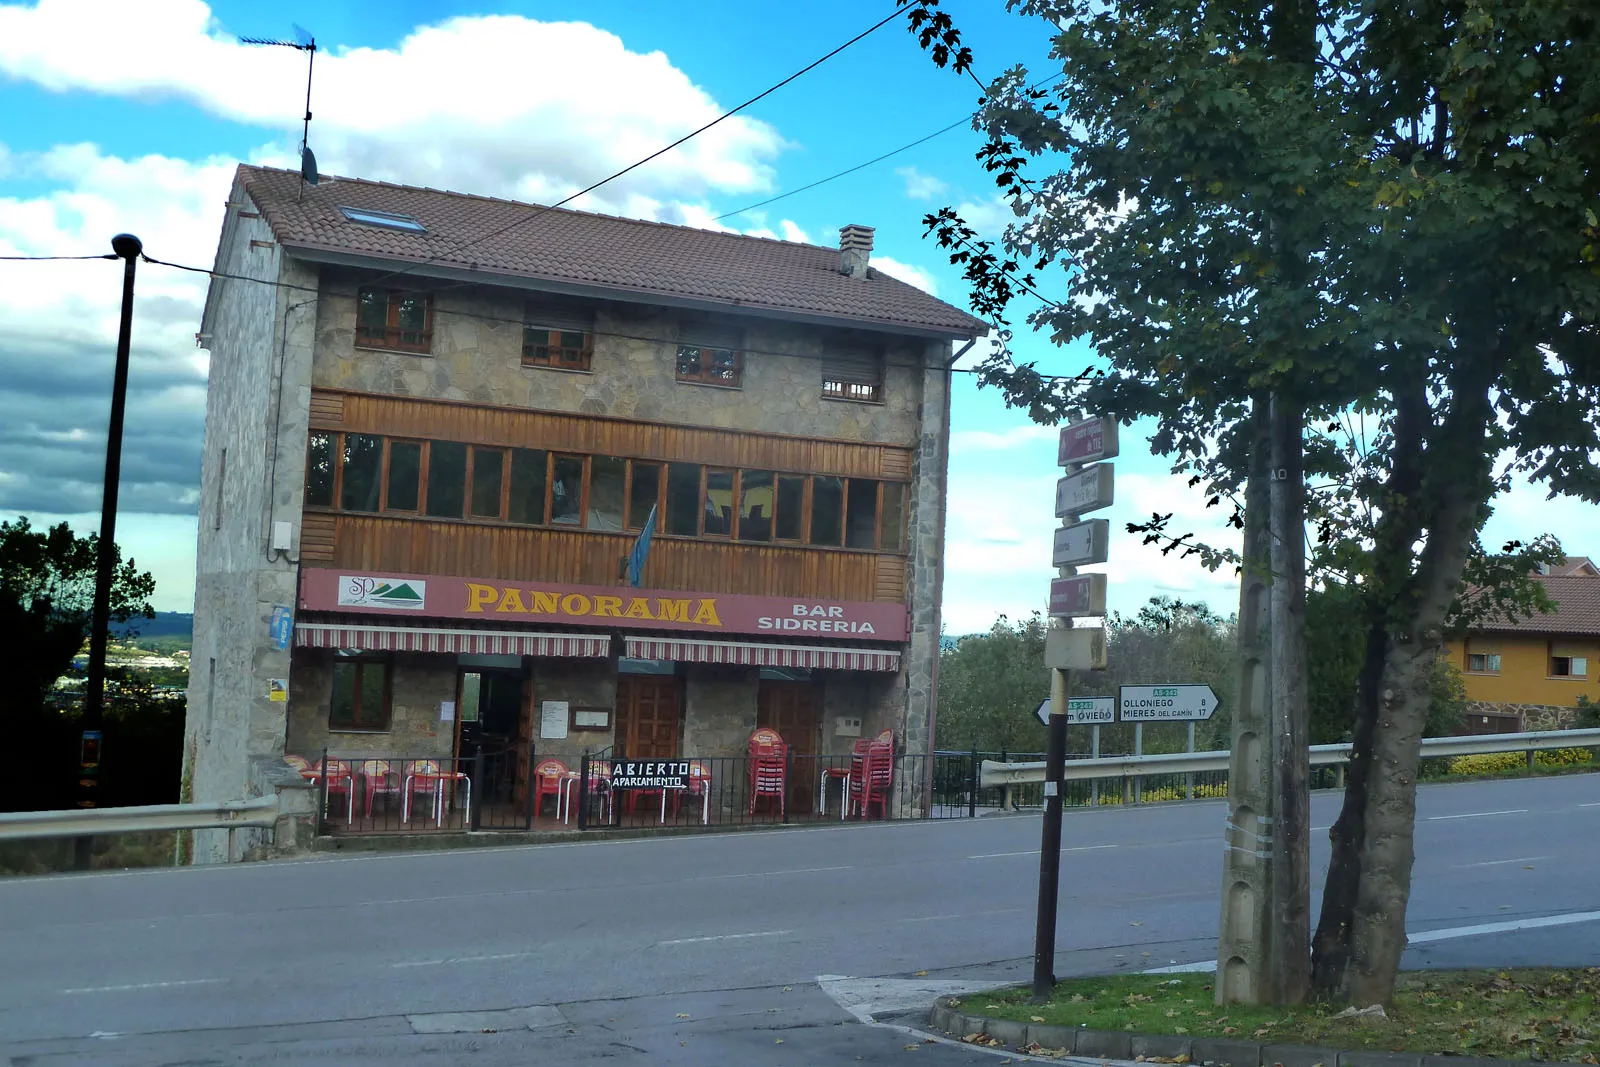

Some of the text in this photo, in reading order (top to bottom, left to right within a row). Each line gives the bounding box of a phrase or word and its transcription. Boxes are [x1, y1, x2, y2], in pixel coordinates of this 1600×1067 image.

[464, 583, 723, 627] PANORAMA
[792, 604, 844, 618] BAR
[757, 617, 876, 634] SIDRERIA
[1154, 688, 1178, 696] AS-242
[1123, 698, 1206, 708] OLLONIEGO 8
[1078, 711, 1112, 720] OVIEDO
[1123, 709, 1156, 718] MIERES
[1198, 708, 1207, 716] 17
[613, 763, 689, 776] ABIERTO
[612, 777, 682, 787] APARCAMIENTO
